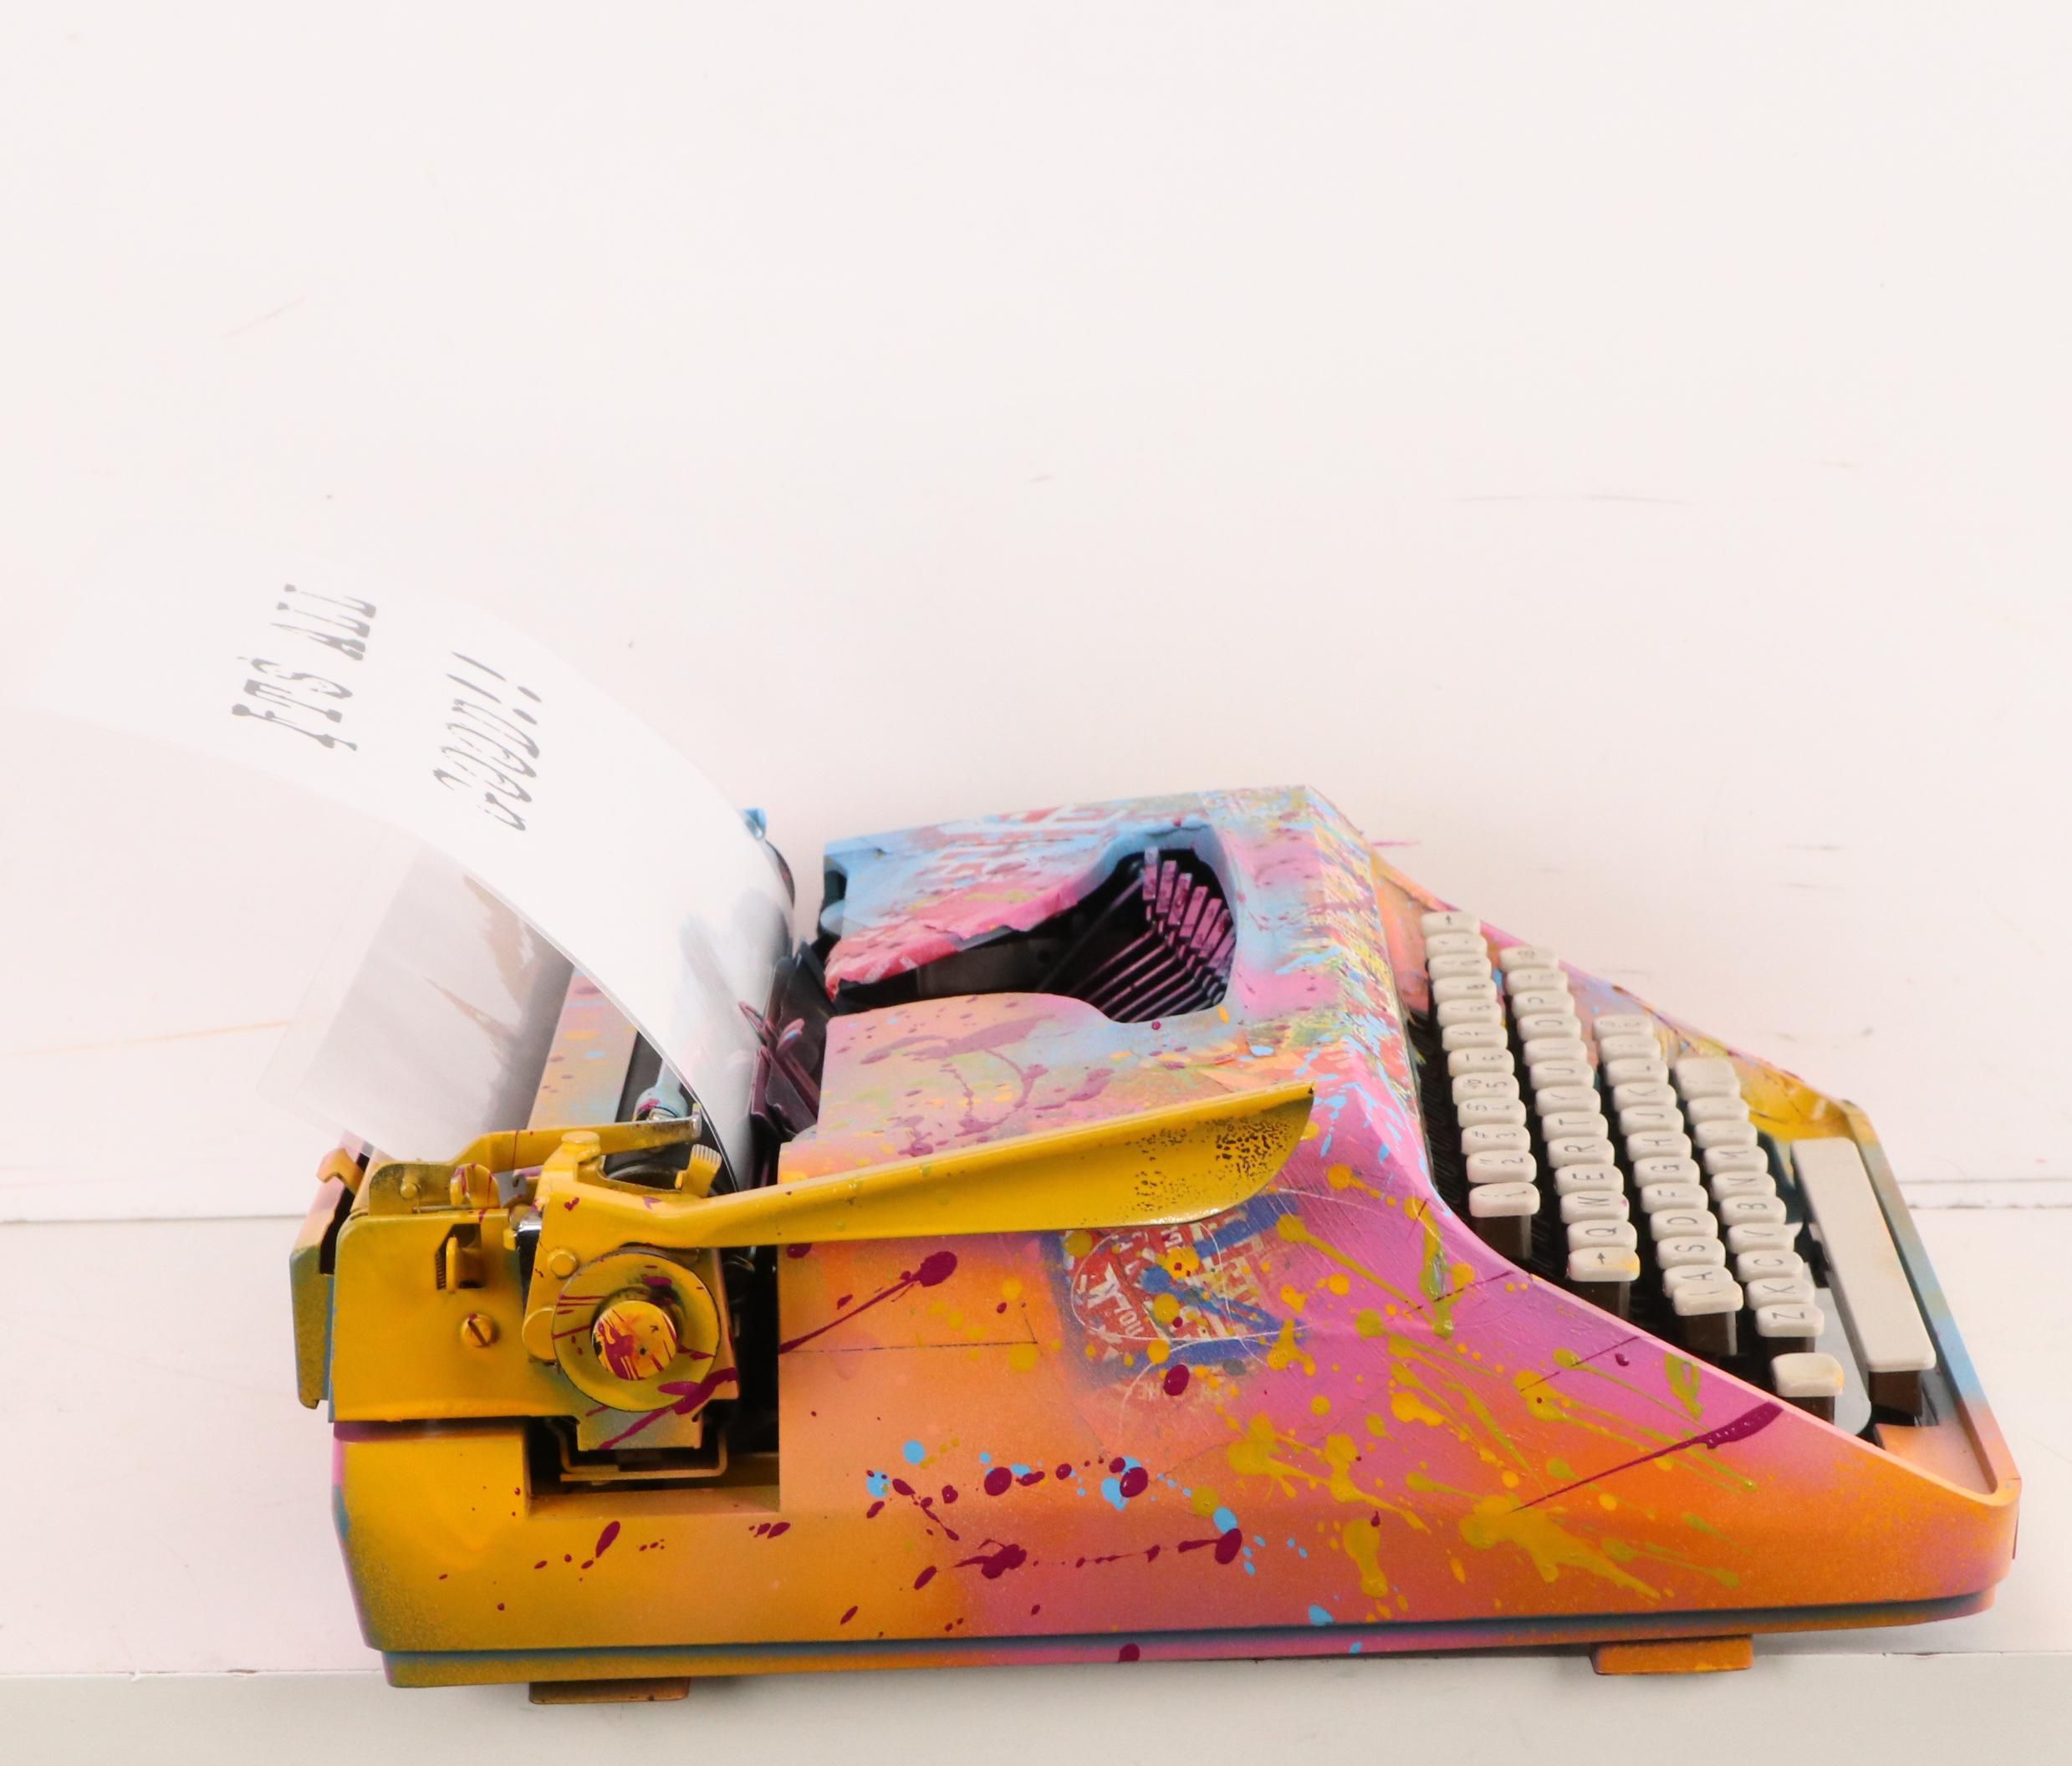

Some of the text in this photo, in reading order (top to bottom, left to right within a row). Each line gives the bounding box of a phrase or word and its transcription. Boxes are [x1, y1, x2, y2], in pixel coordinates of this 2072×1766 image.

[270, 584, 376, 661] ALL
[432, 651, 542, 831] GOOD!!
[1557, 1117, 1591, 1126] T
[1641, 1137, 1673, 1147] H
[1563, 1144, 1596, 1153] R
[1650, 1163, 1681, 1172] G
[1726, 1176, 1758, 1187] N
[1576, 1195, 1611, 1208] W
[1736, 1202, 1768, 1211] B
[1666, 1216, 1699, 1226] D
[1584, 1227, 1618, 1238] Q
[1673, 1243, 1707, 1253] S
[1752, 1258, 1785, 1268] C
[1680, 1270, 1714, 1282] A
[1761, 1284, 1797, 1295] X
[1771, 1311, 1807, 1320] Z
